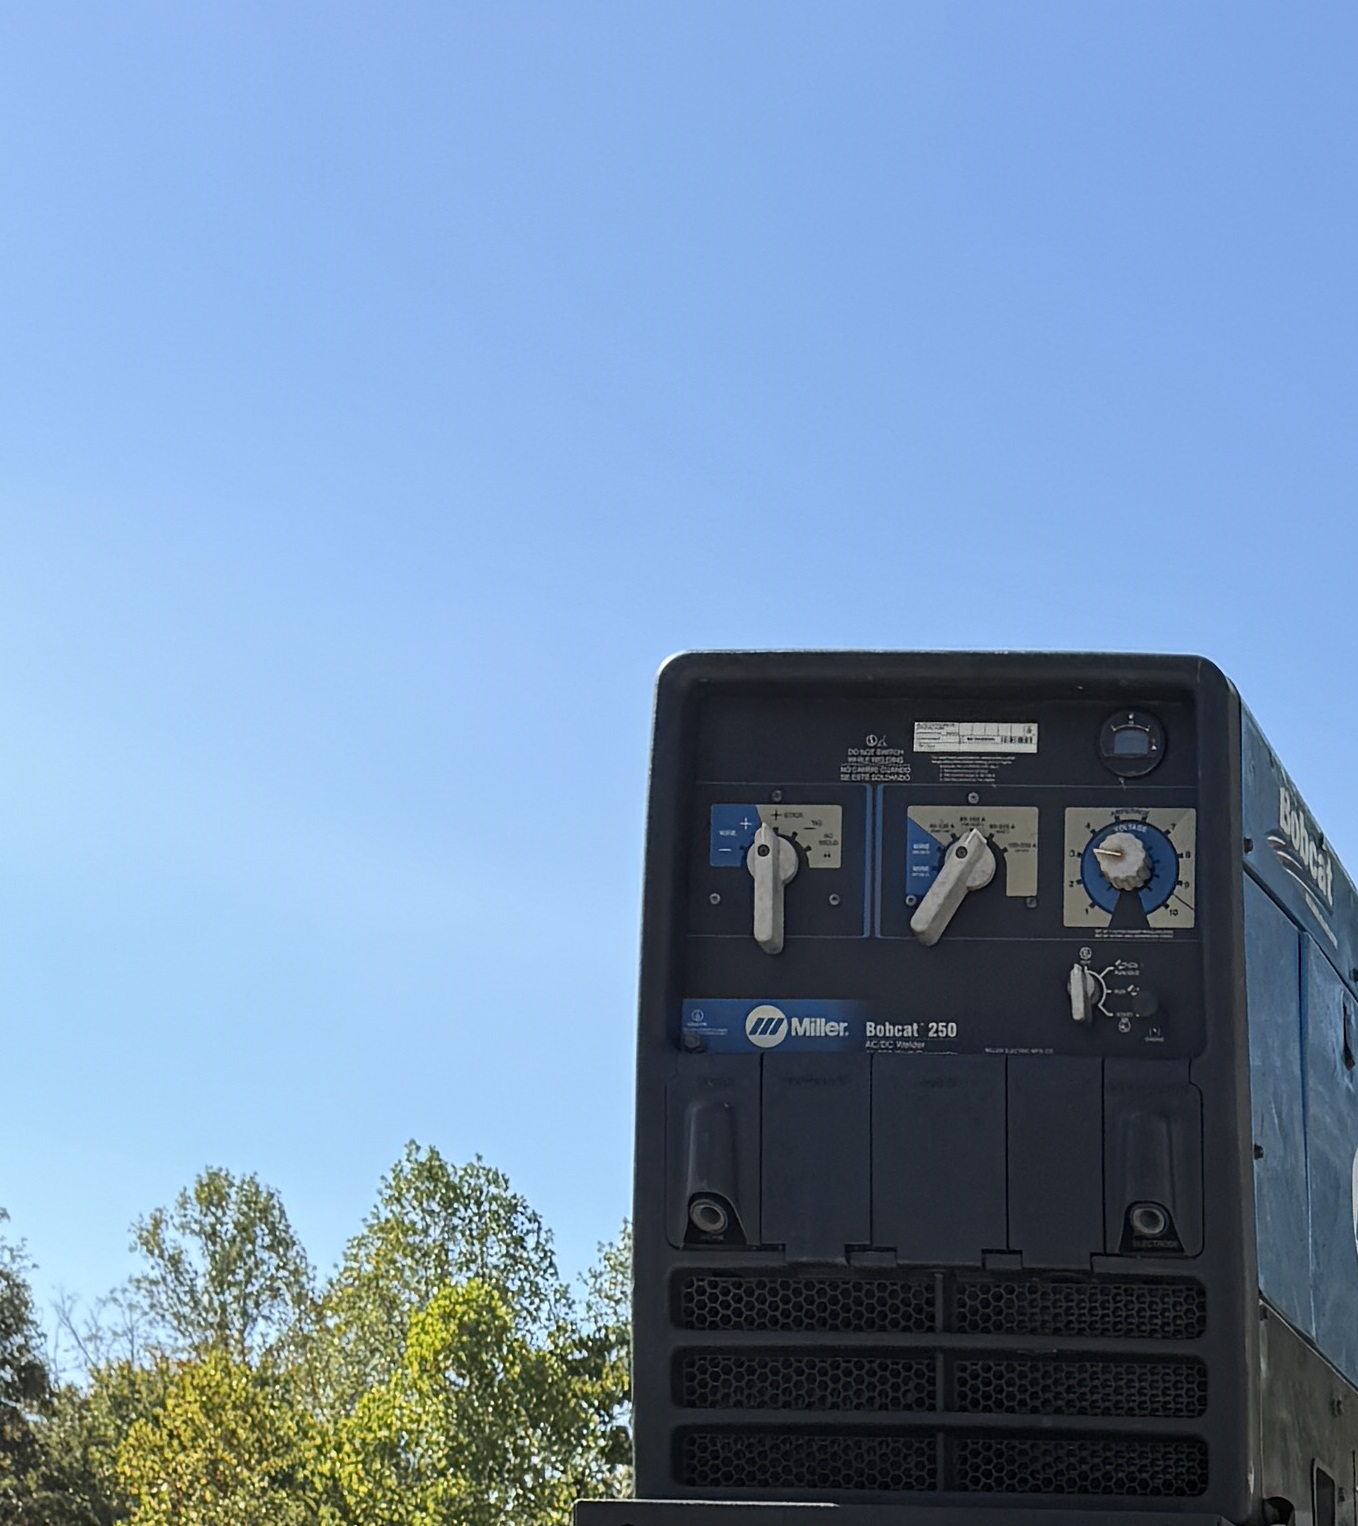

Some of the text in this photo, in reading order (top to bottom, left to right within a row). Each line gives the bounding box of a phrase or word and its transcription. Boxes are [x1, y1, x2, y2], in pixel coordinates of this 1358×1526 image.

[1114, 824, 1148, 833] VOLTAGE
[1279, 787, 1334, 907] Bobcat
[790, 1017, 846, 1037] Miller
[866, 1022, 957, 1038] Bobcat 250
